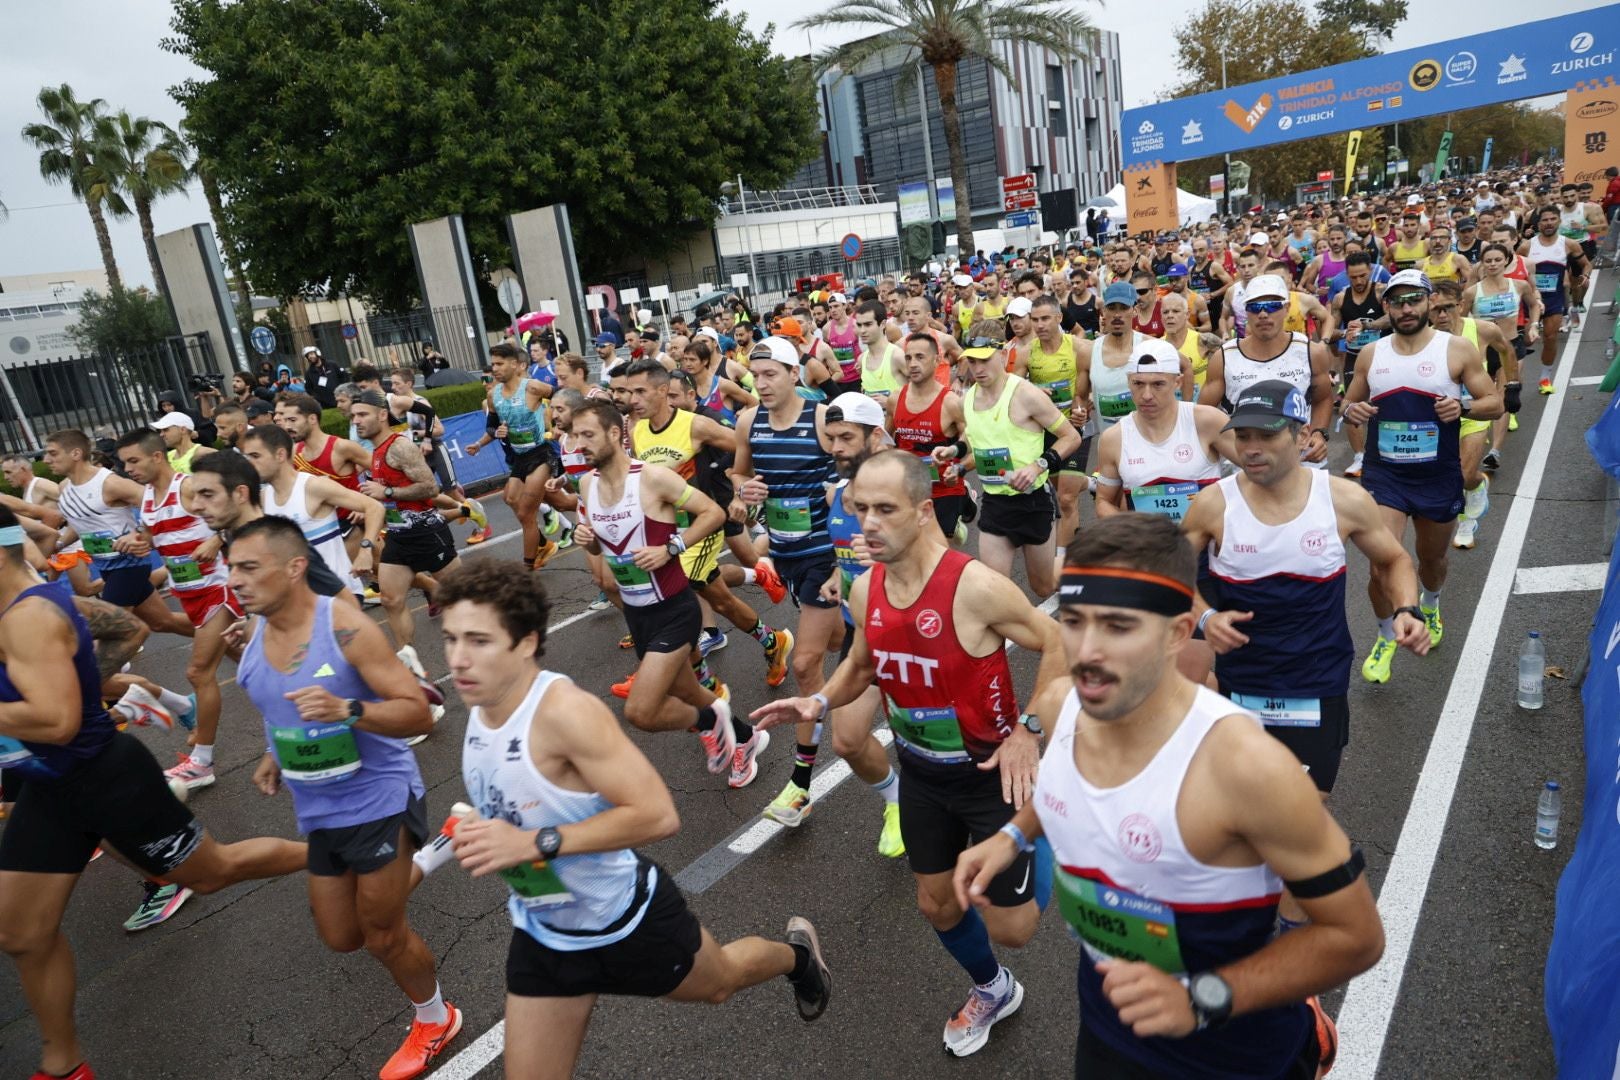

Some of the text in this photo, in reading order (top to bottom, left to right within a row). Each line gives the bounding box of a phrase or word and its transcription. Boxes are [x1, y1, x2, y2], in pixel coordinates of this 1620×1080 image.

[1551, 52, 1613, 75] ZURICH
[1278, 79, 1335, 100] VALENCIA
[1279, 81, 1403, 114] TRINIDAD ALFONSO
[1246, 101, 1267, 127] 21K
[1296, 110, 1335, 125] ZURICH
[1132, 137, 1164, 148] TRINIDAD
[1133, 143, 1164, 155] ALFONSO
[1350, 138, 1358, 156] 1
[1441, 138, 1450, 151] 2
[1395, 434, 1419, 442] 1244
[1393, 446, 1420, 454] Bergua
[1153, 499, 1179, 508] 1423
[592, 510, 633, 523] BORDEAUX
[873, 649, 938, 688] ZTT
[1263, 699, 1286, 710] Javi
[1122, 897, 1164, 915] ZURICH
[1078, 904, 1127, 937] 1083
